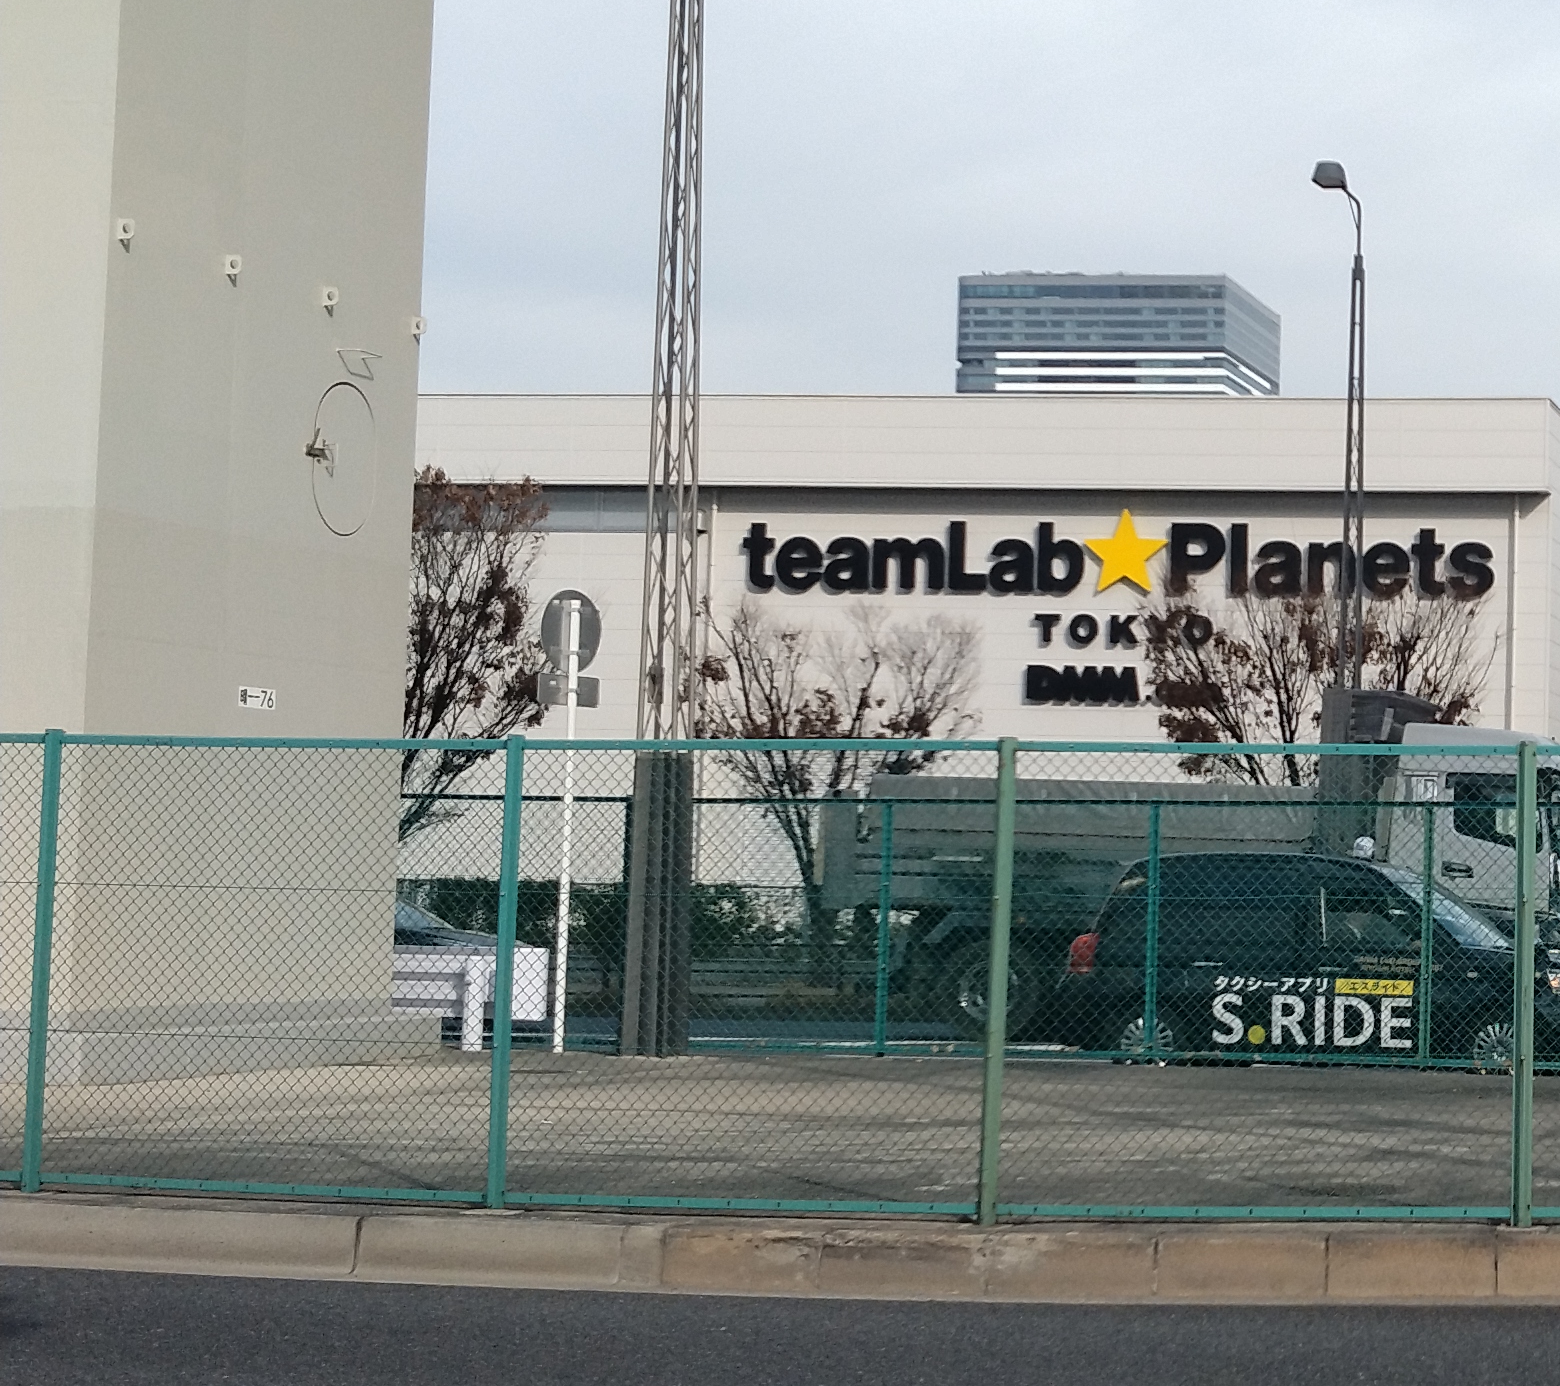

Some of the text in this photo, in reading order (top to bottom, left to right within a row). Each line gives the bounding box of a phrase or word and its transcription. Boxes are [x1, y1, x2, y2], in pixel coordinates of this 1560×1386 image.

[743, 521, 1495, 596] teamLab Planets
[1213, 976, 1329, 993] タクシーアプリ
